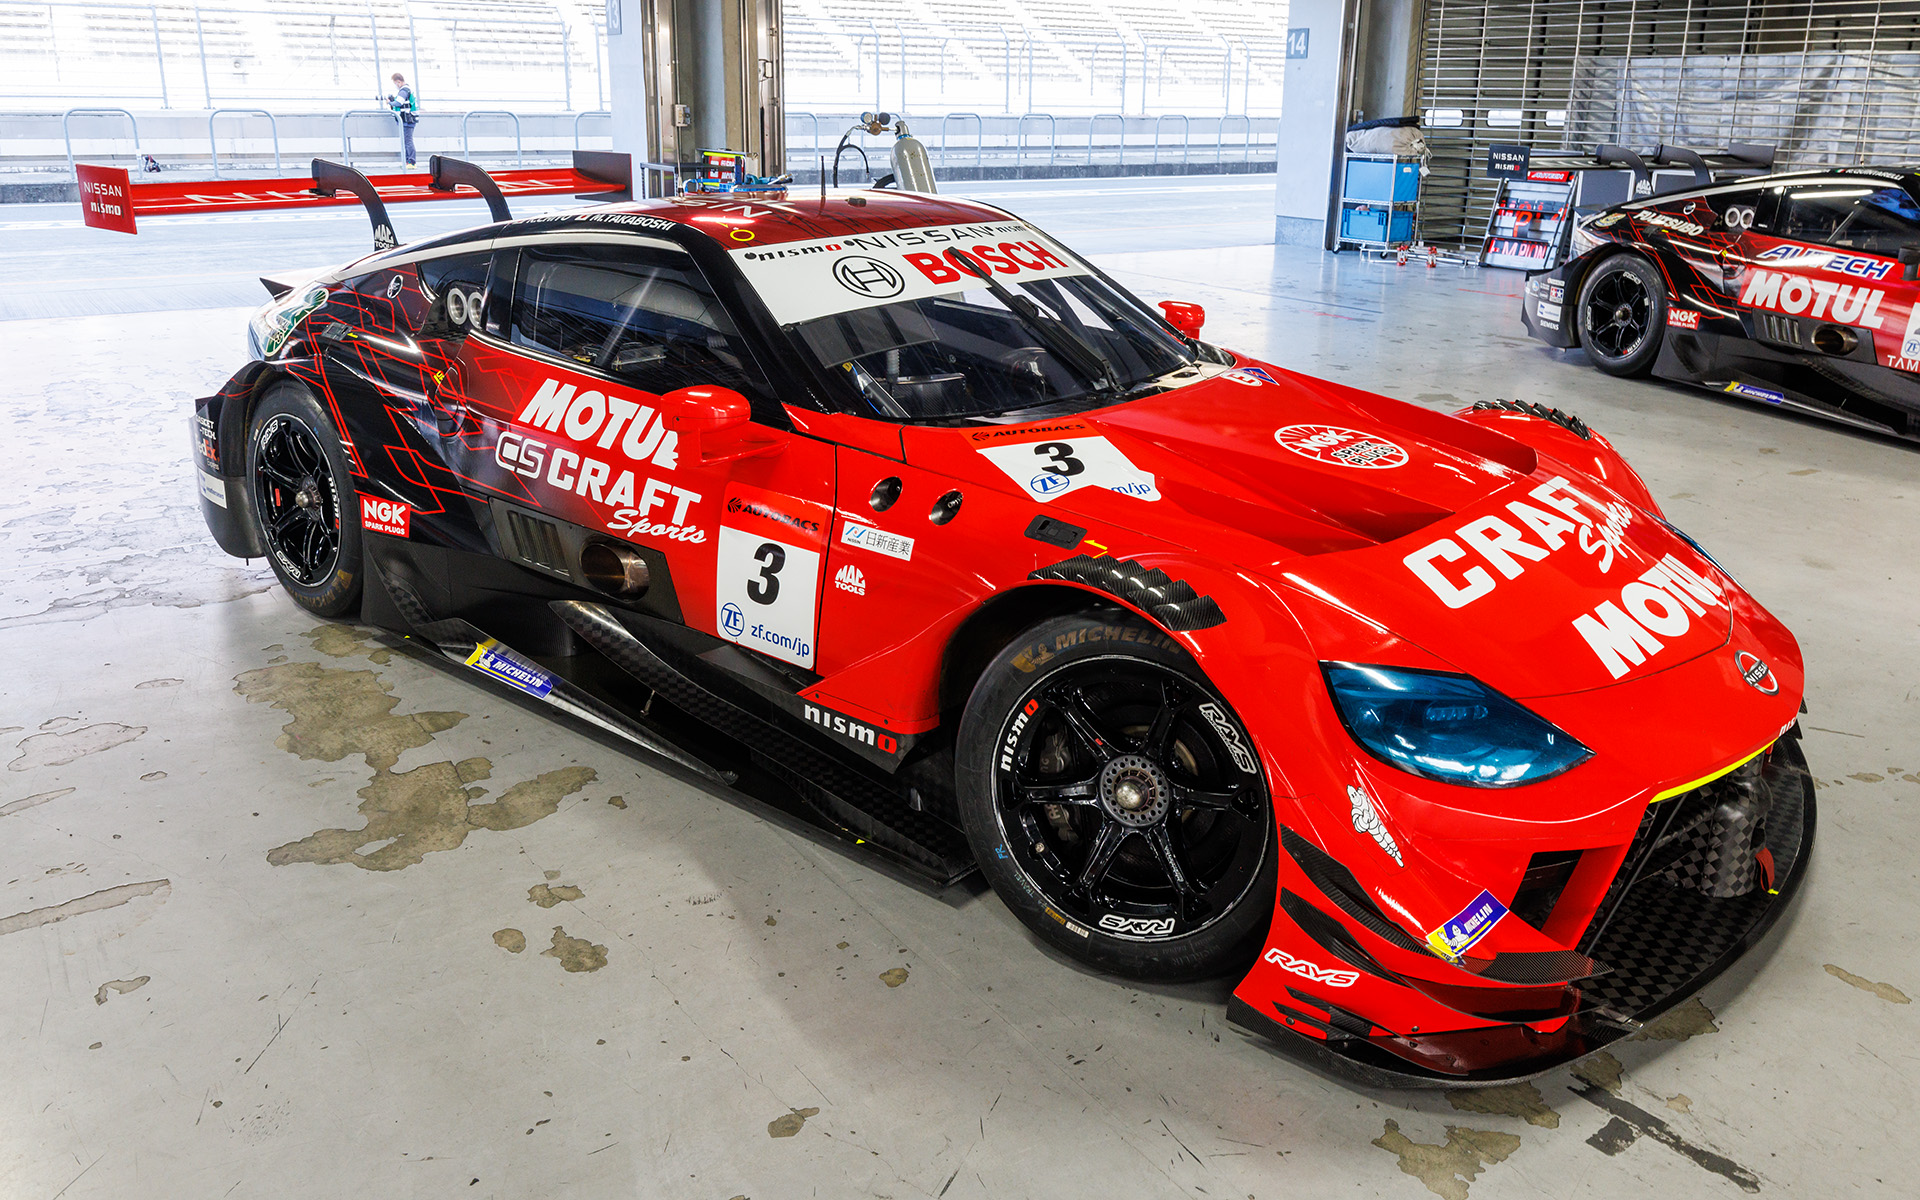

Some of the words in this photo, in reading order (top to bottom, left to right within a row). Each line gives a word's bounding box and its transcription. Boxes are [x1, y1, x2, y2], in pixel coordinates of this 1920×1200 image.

[1288, 32, 1306, 56] 14
[1493, 153, 1525, 162] NISSAN
[83, 181, 123, 198] NISSAN
[90, 201, 121, 216] nismo
[374, 223, 395, 243] MAC
[591, 214, 677, 232] M.TAKABOSHI
[758, 243, 842, 261] nismo
[851, 225, 995, 250] NISSAN
[902, 240, 1069, 286] BOSCH
[1741, 270, 1885, 329] MOTUL
[1669, 308, 1698, 323] NGK
[993, 424, 1086, 438] AUTOBACS
[1291, 429, 1355, 452] NGK
[1034, 442, 1086, 477] 3
[1331, 440, 1376, 461] SPARK
[1350, 446, 1397, 466] PLUGS
[546, 447, 702, 527] CRAFT
[363, 498, 406, 526] NGK
[607, 508, 707, 544] Sports
[742, 504, 820, 532] AUTOBACS
[364, 520, 384, 532] SPARK
[384, 525, 406, 535] PLUGS
[865, 532, 910, 555] 日新産業
[747, 542, 787, 606] 3
[834, 580, 866, 596] TOOLS
[835, 564, 866, 588] MAC
[1571, 552, 1729, 681] MOTUL
[750, 624, 810, 658] zf.com/jp
[1054, 625, 1181, 655] MICHELIN
[491, 659, 544, 688] MICHELIN
[804, 703, 898, 755] nismo
[1001, 698, 1040, 772] nismo
[1199, 702, 1257, 774] RAYS
[1099, 913, 1176, 936] RAYS
[1265, 947, 1360, 988] RAYS
